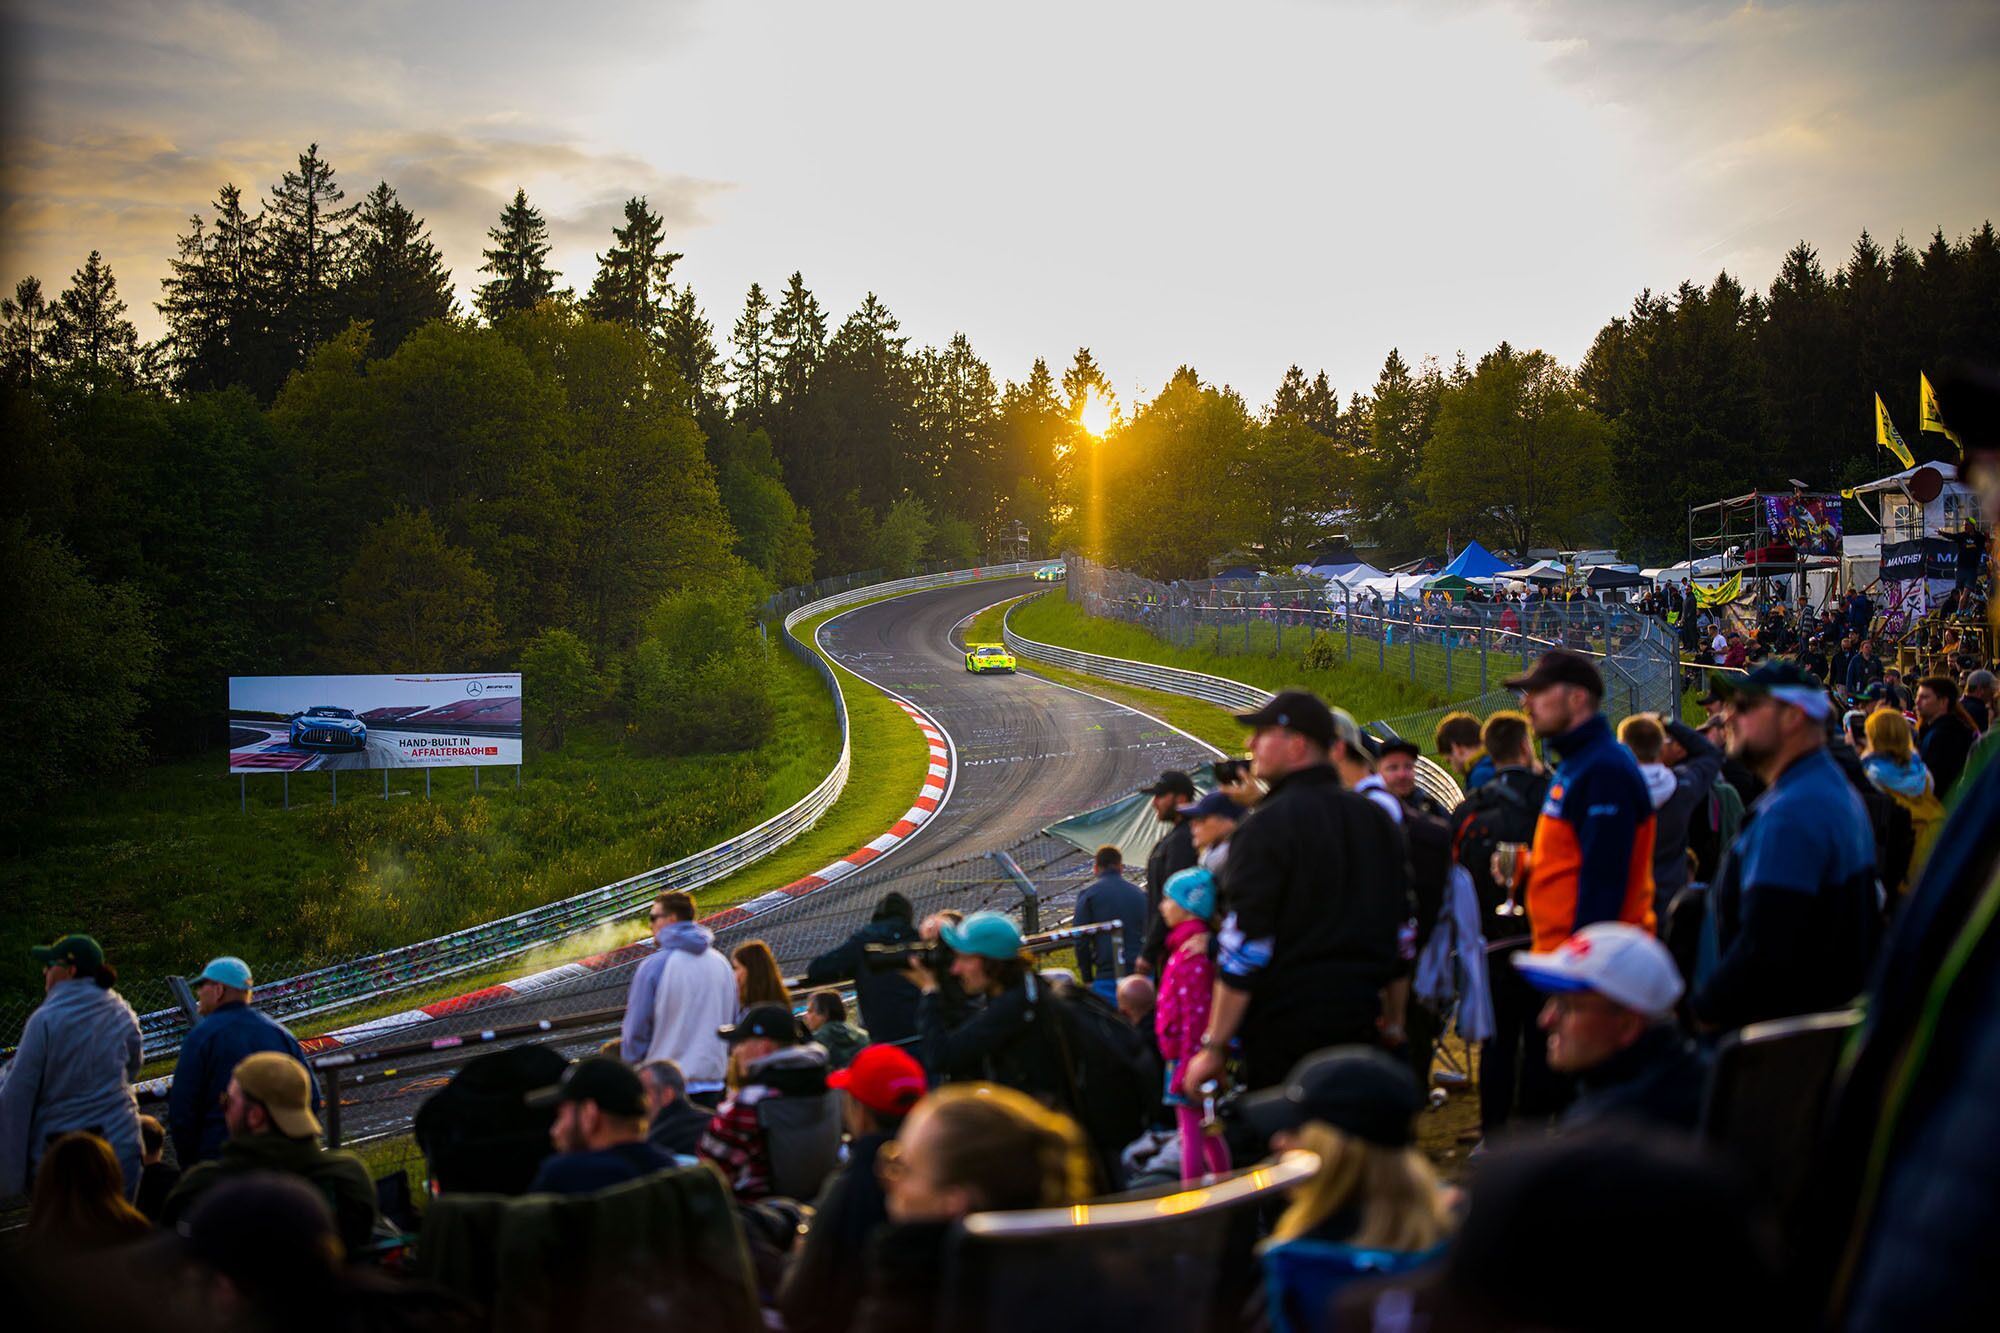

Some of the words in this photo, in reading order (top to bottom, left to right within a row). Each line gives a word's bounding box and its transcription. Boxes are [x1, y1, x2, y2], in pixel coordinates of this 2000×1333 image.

[1886, 552, 1923, 568] MANTHEY
[399, 737, 458, 747] HAND-BUILT
[460, 737, 470, 746] IN
[411, 747, 484, 757] AFFALTERBACH
